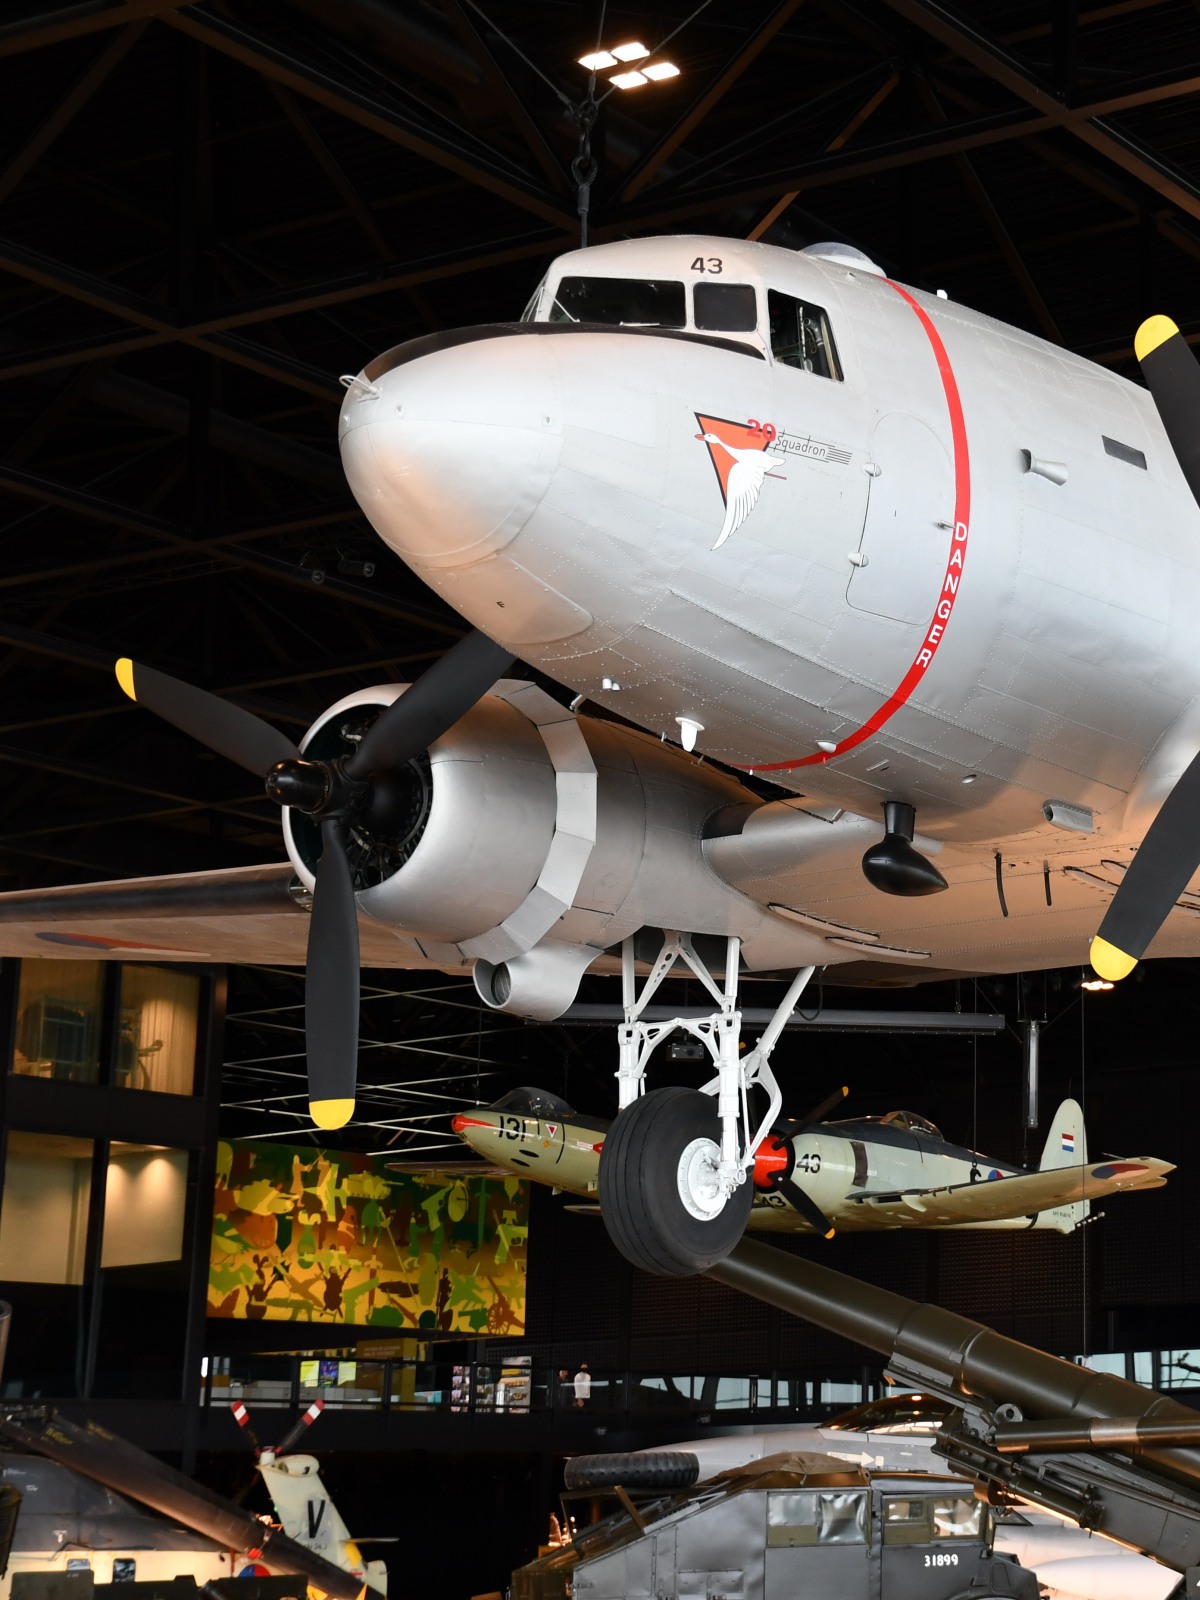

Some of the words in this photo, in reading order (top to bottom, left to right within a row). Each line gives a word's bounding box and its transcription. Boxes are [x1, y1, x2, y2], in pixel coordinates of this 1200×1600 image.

[691, 257, 722, 274] 43
[747, 419, 776, 441] 20
[774, 430, 826, 457] Squadron
[916, 522, 967, 668] DANGER
[499, 1116, 526, 1141] 131
[796, 1153, 821, 1173] 43
[308, 1500, 325, 1538] V
[924, 1553, 959, 1567] 31899
